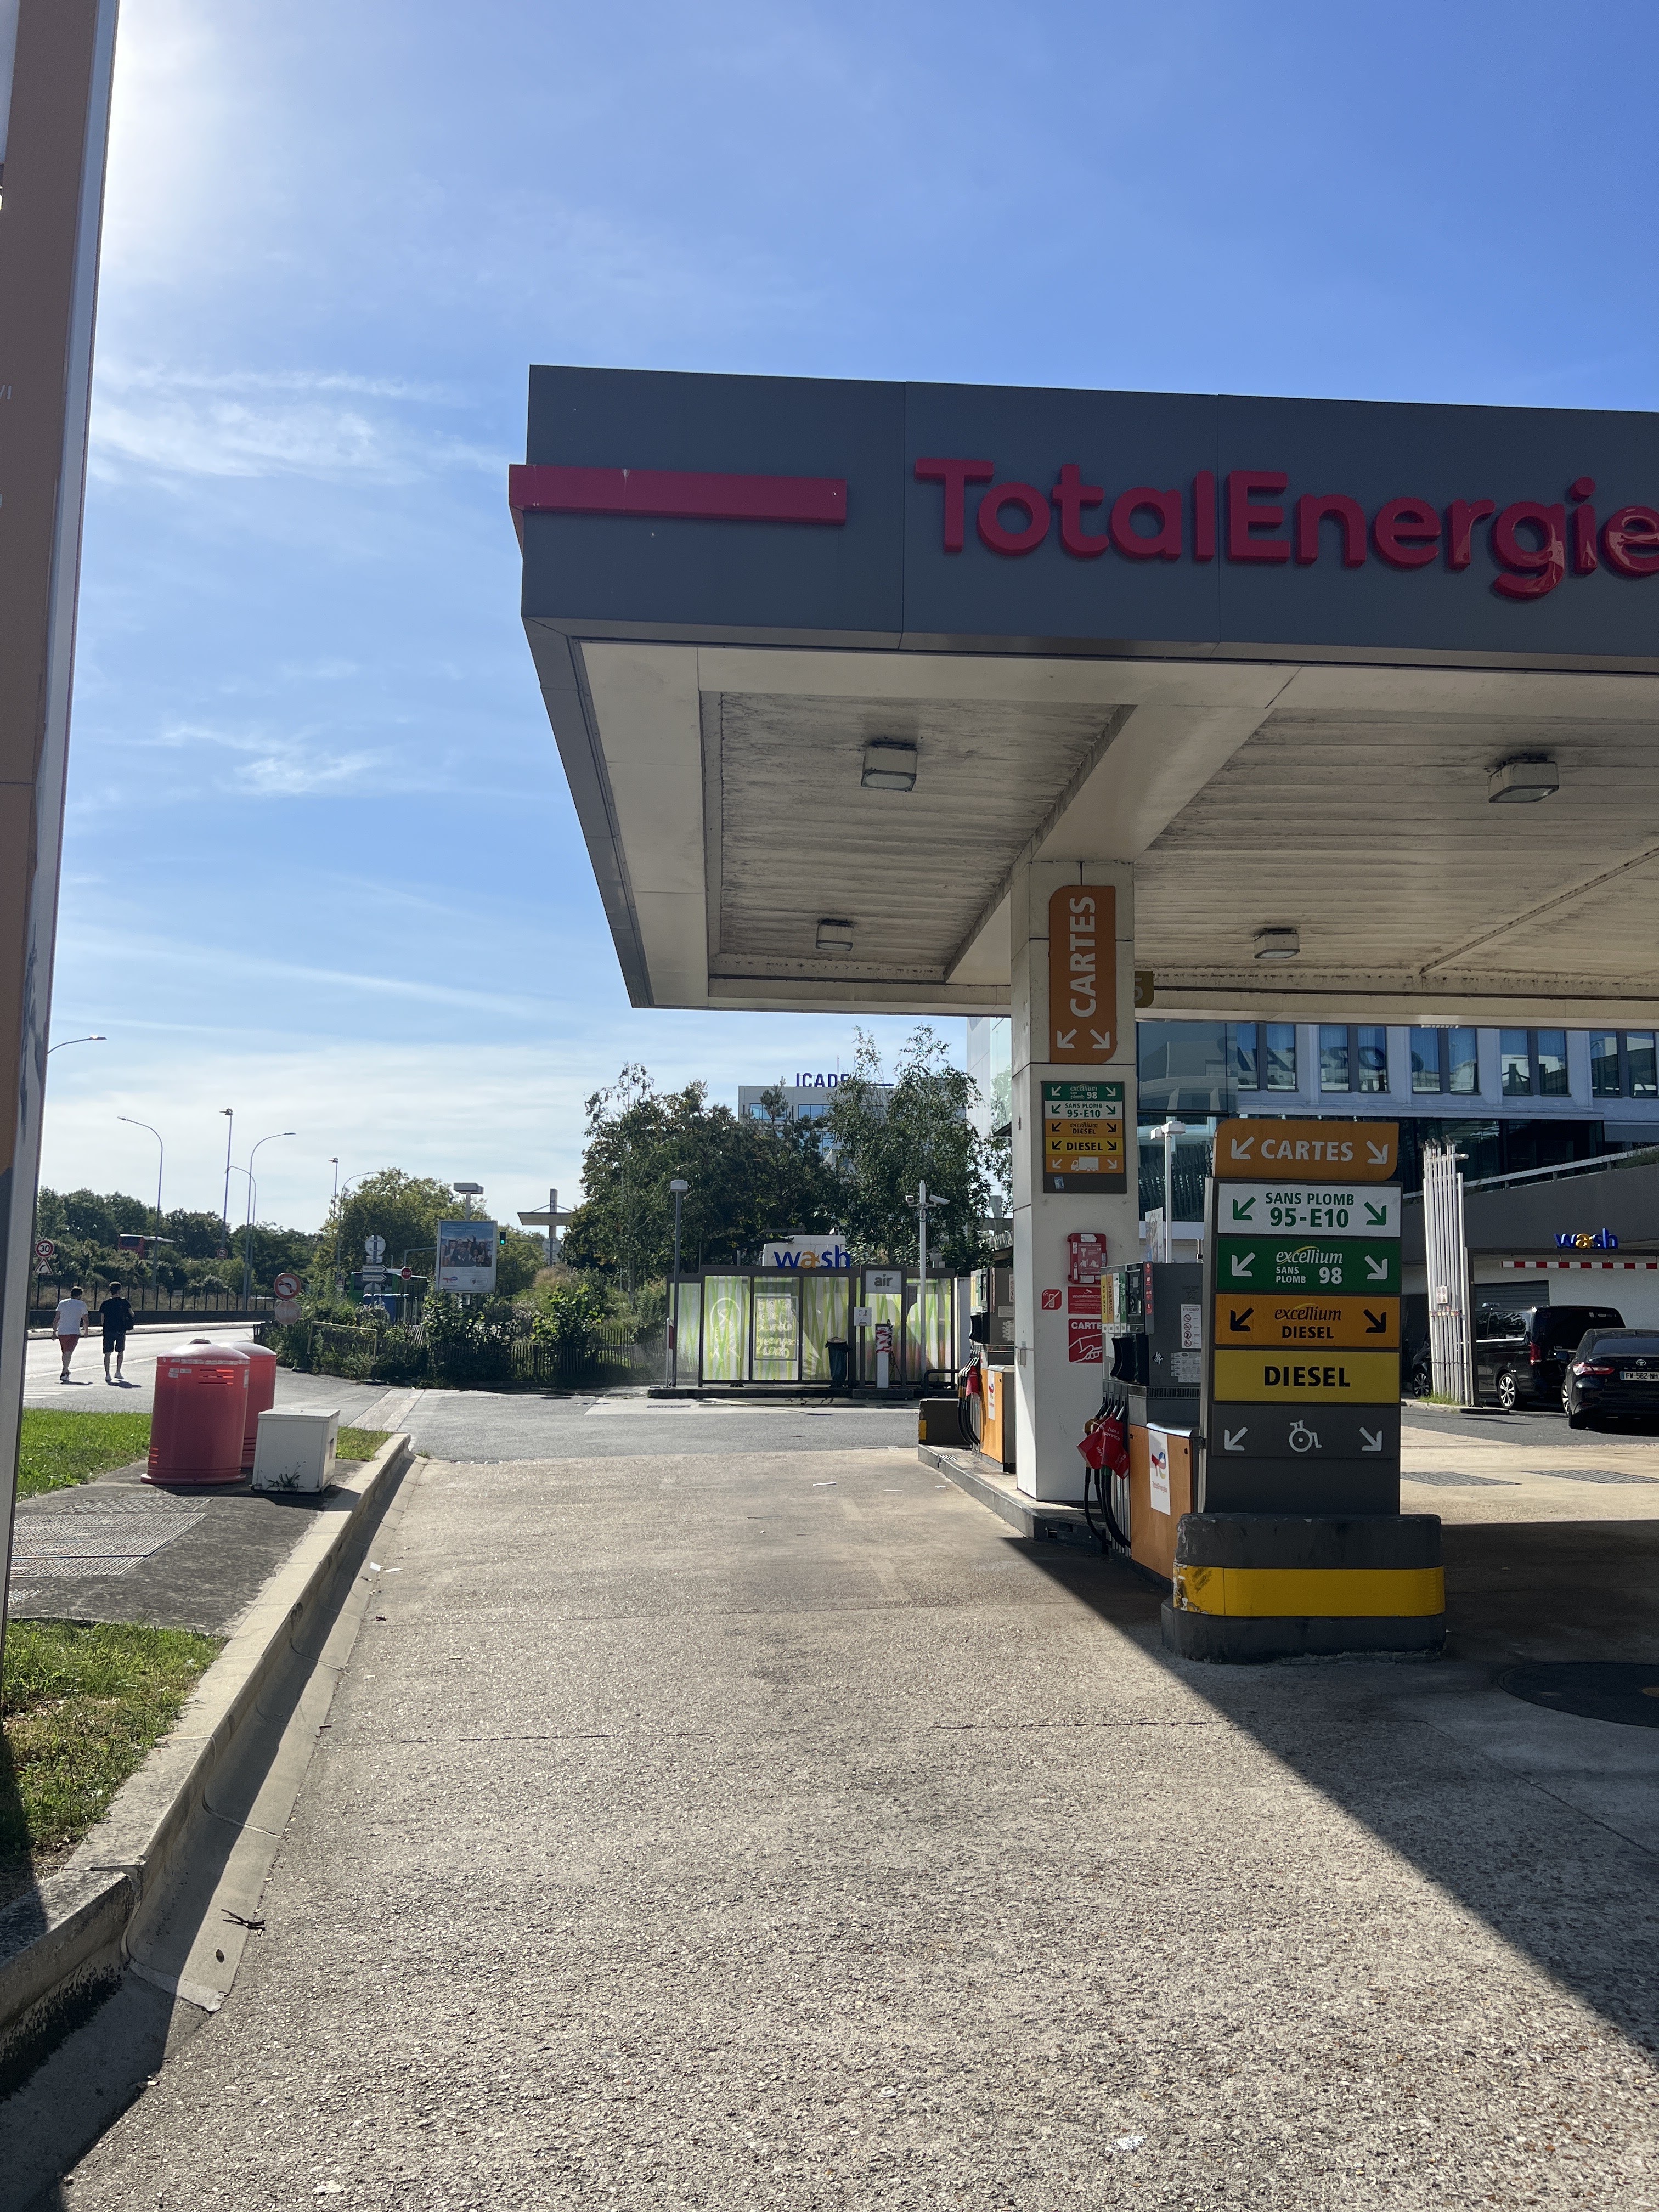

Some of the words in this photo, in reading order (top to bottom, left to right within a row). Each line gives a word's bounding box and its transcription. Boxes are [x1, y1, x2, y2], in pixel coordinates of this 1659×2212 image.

[914, 457, 1659, 600] TotalEnergie
[1070, 896, 1096, 1018] CARTES
[1087, 1091, 1097, 1099] 98
[1067, 1109, 1101, 1118] 95-E10
[1066, 1142, 1103, 1151] DIESEL
[1261, 1139, 1353, 1162] CARTES
[1266, 1192, 1302, 1205] SANS
[1307, 1193, 1354, 1206] PLOMB
[1270, 1207, 1349, 1228] 95-E10
[1553, 1228, 1618, 1249] wash
[774, 1245, 850, 1269] wash
[1276, 1248, 1342, 1264] excellium
[1276, 1266, 1299, 1274] SANS
[1319, 1267, 1342, 1284] 98
[874, 1274, 893, 1287] air
[1276, 1275, 1306, 1283] PLOMB
[1274, 1305, 1342, 1321] excellium
[1071, 1322, 1102, 1330] CARTE
[1282, 1325, 1334, 1339] DIESEL
[1264, 1365, 1351, 1387] DIESEL
[1108, 1426, 1120, 1435] hors
